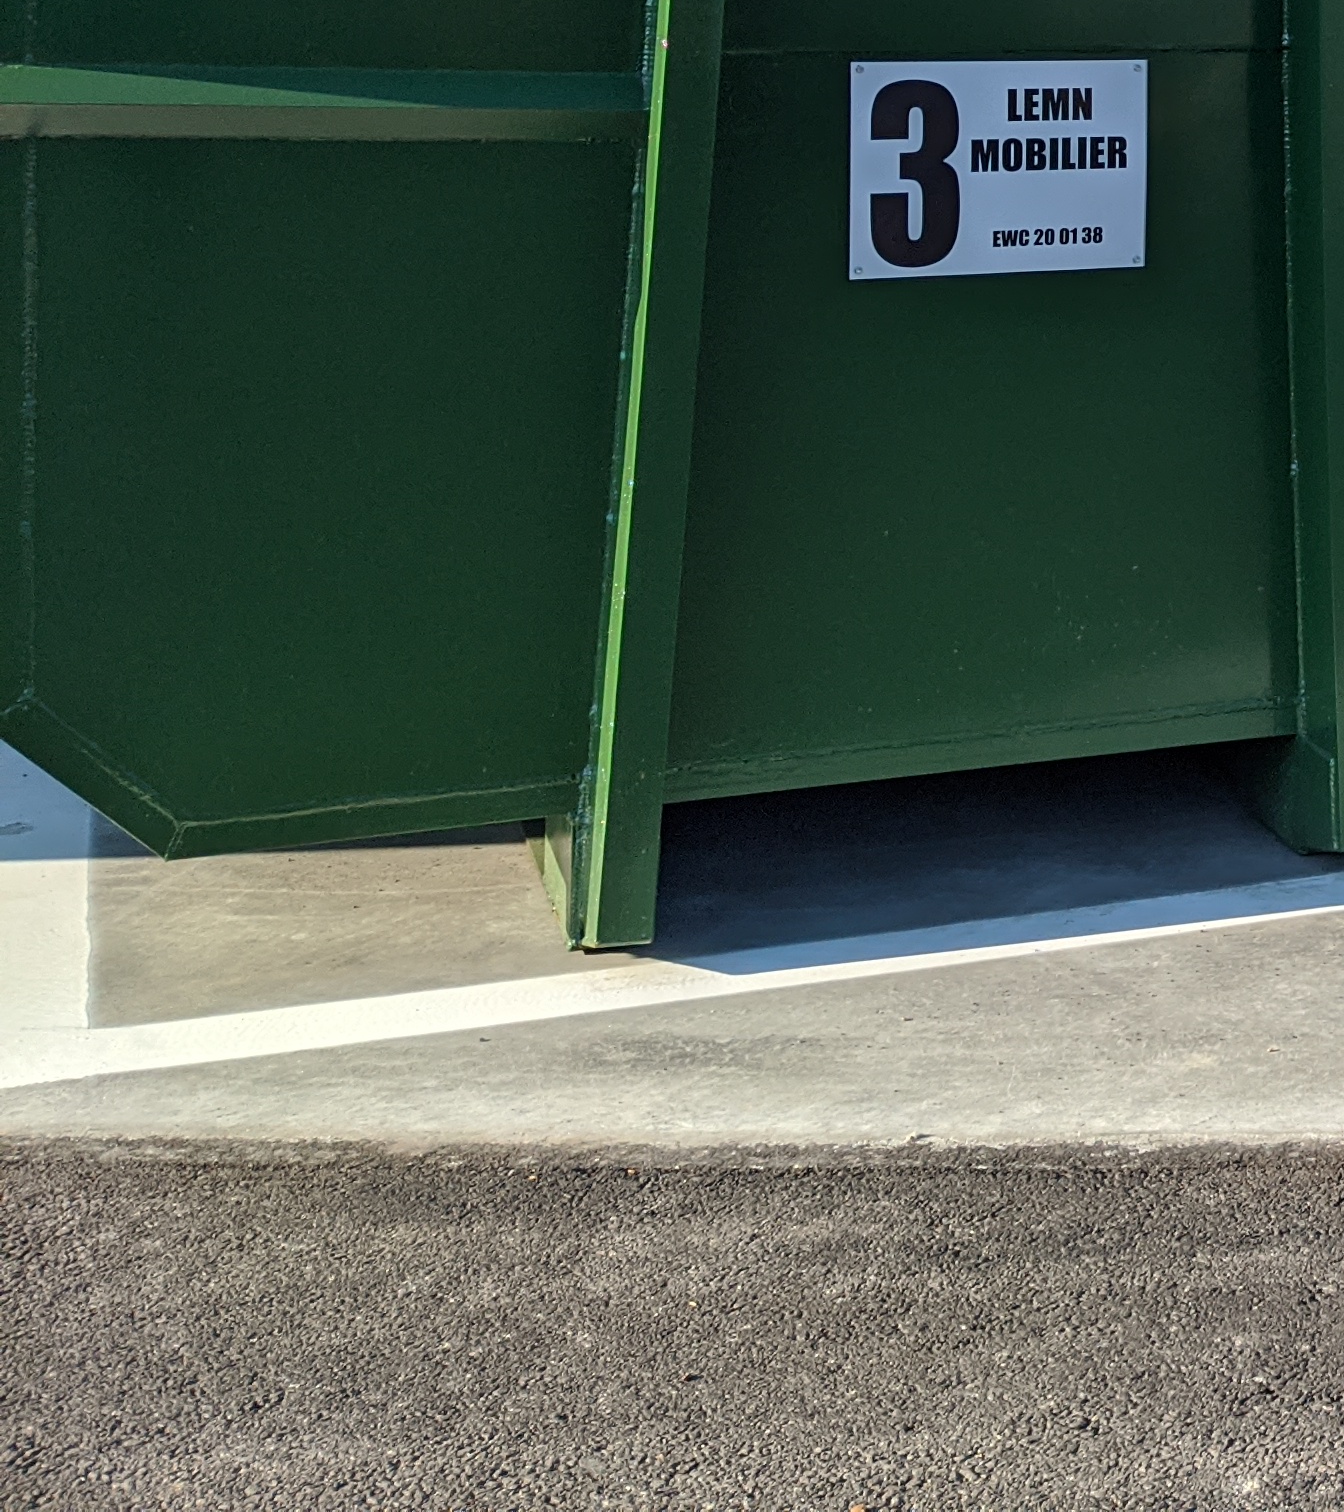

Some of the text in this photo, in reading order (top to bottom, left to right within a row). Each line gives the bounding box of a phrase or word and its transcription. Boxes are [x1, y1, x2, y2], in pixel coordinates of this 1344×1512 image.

[1007, 87, 1093, 122] LEMN
[970, 136, 1128, 173] MOBILIER
[870, 79, 960, 268] 3
[992, 226, 1103, 248] EWC 20 01 38
